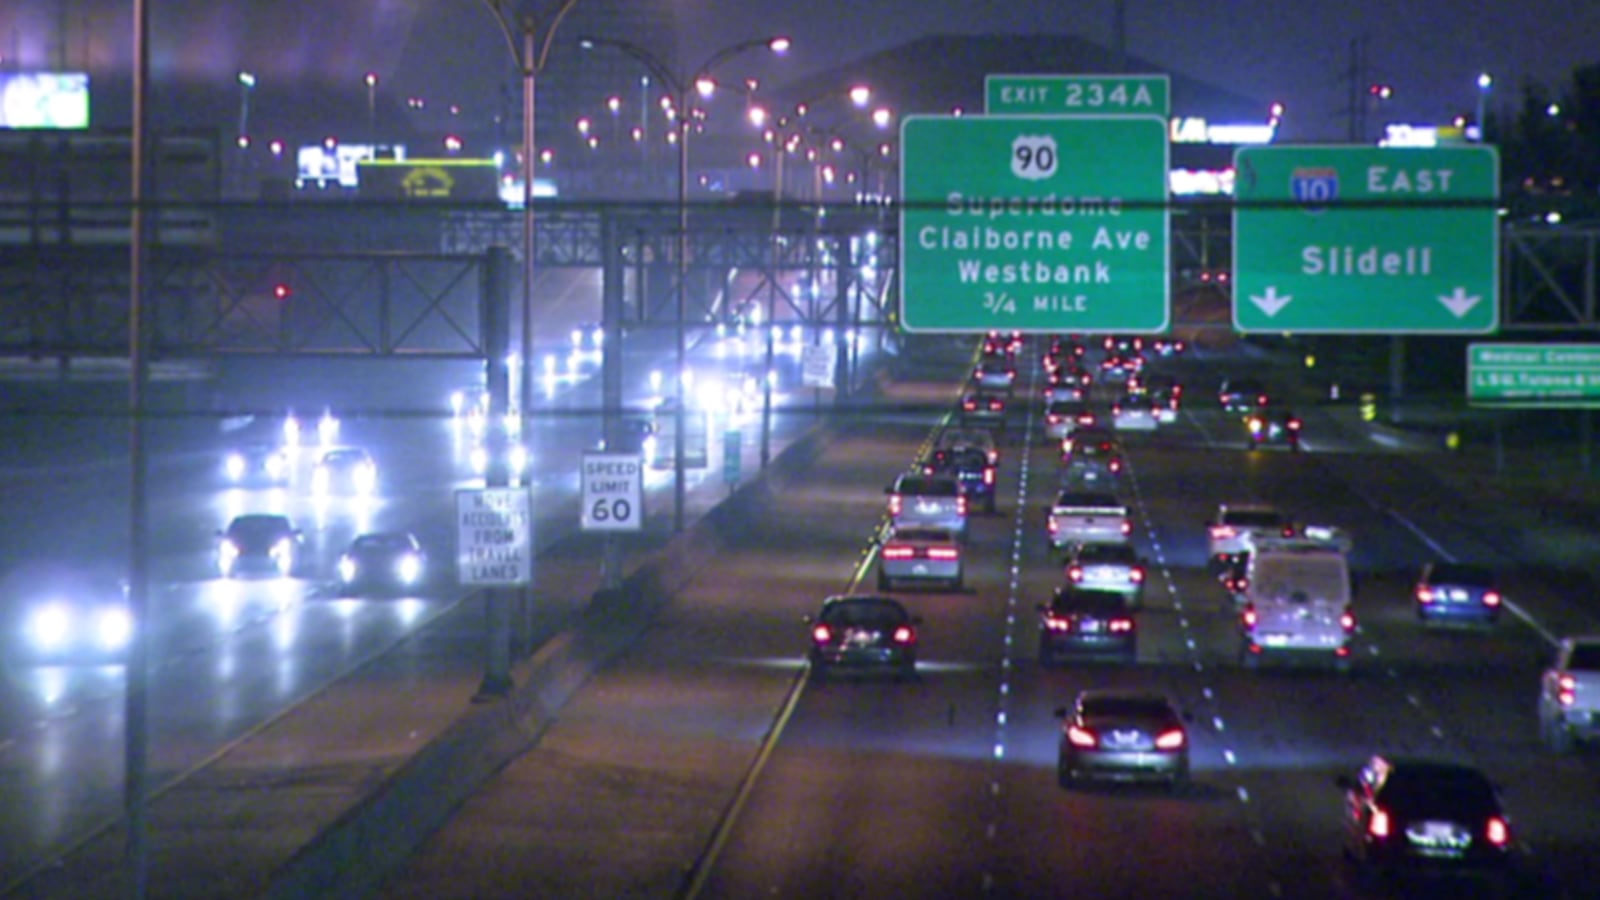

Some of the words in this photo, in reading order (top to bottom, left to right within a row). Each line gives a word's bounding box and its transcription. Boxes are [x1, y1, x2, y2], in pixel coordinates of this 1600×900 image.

[1001, 87, 1048, 103] EXIT
[1065, 84, 1152, 106] 234A
[1016, 145, 1053, 172] 90
[1301, 179, 1329, 204] 10
[1367, 165, 1452, 193] EAST
[946, 191, 1123, 219] Superdome
[919, 226, 1073, 249] Claiborne
[1091, 226, 1151, 249] Ave
[958, 260, 1110, 283] Westbank
[1302, 246, 1430, 275] Slidell
[983, 292, 1016, 314] 3/4
[1034, 295, 1087, 311] MILE
[586, 461, 637, 475] SPEED
[590, 481, 631, 494] LIMIT
[592, 498, 631, 521] 60
[474, 529, 514, 544] FROM
[471, 564, 519, 580] LANES
